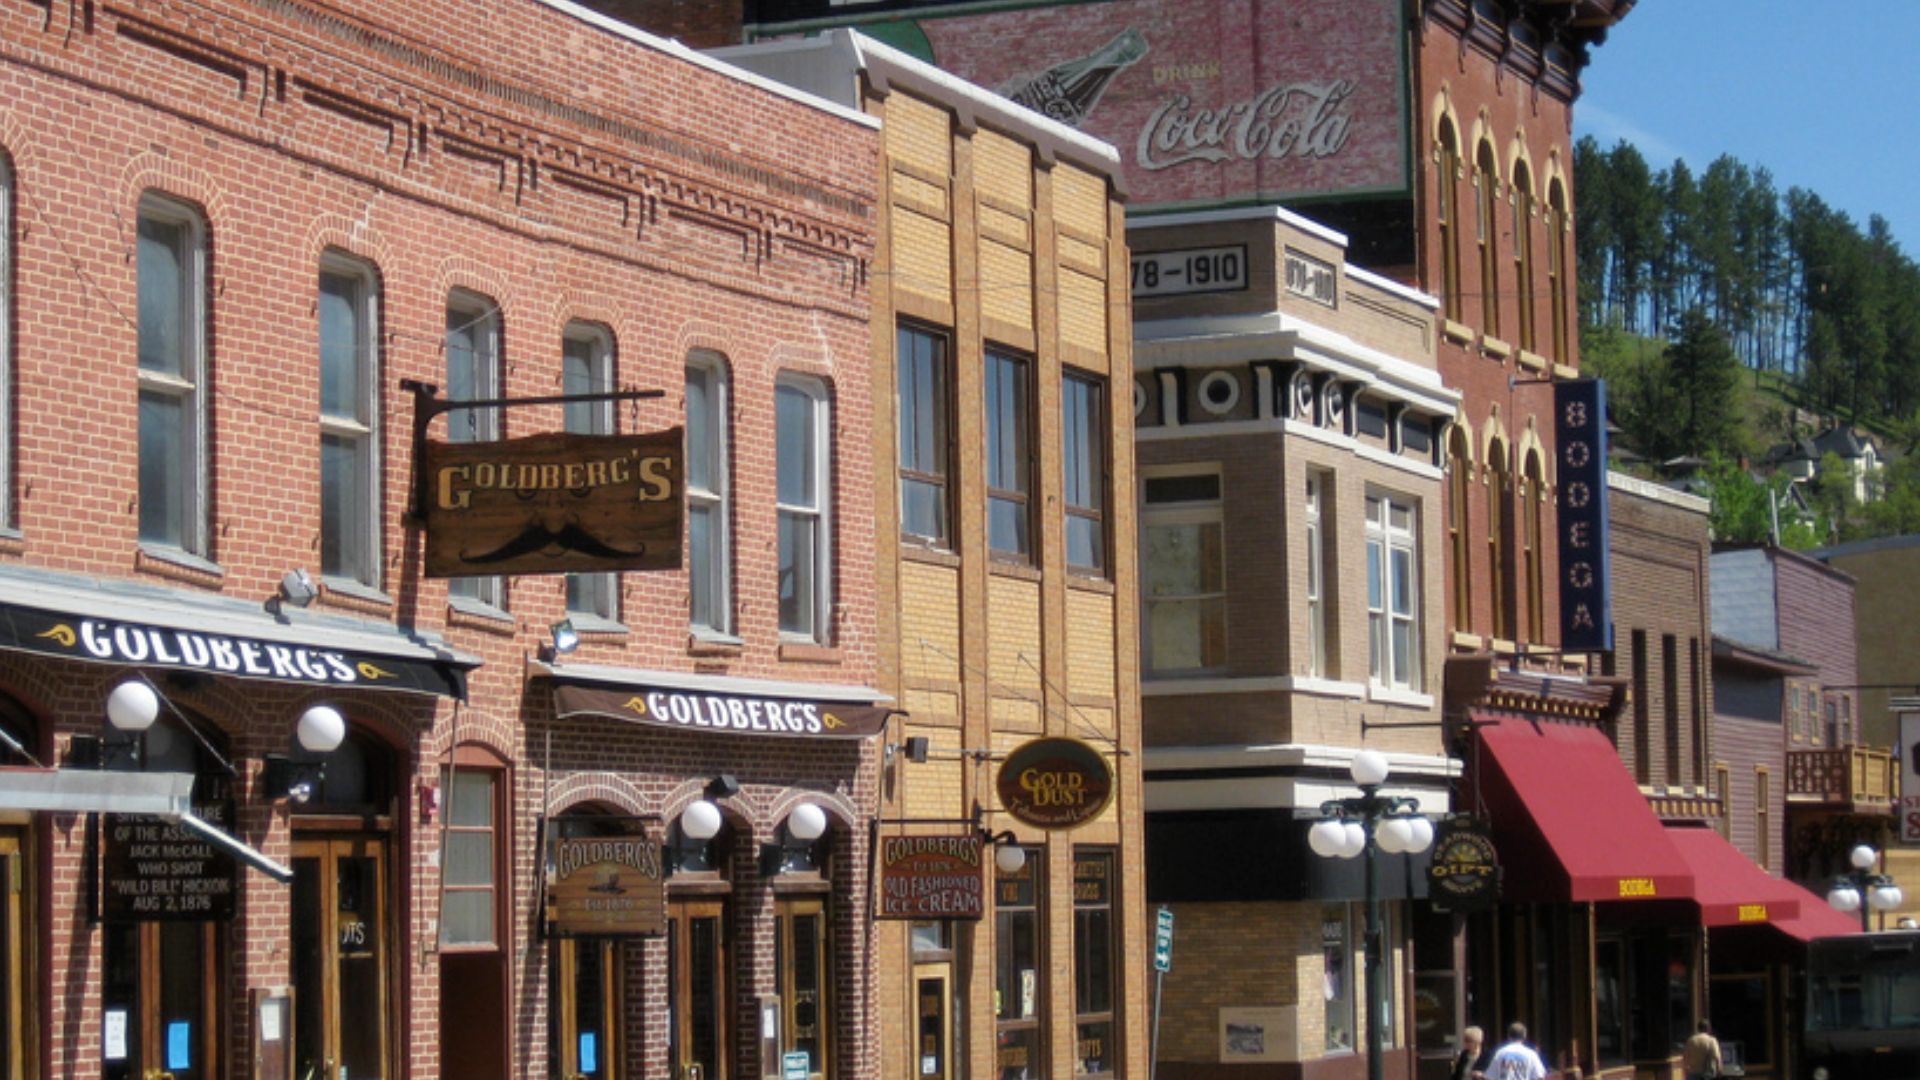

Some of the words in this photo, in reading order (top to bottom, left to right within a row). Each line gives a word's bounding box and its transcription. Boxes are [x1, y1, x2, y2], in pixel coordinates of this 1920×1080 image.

[1152, 62, 1222, 82] DRINK
[437, 449, 672, 511] GOLDBERG'S
[1565, 401, 1594, 630] BODEGA
[1020, 768, 1083, 792] GOLD
[1033, 784, 1088, 807] DUST
[113, 825, 131, 842] OF
[135, 826, 158, 841] THE
[129, 845, 159, 859] JACK
[162, 845, 214, 858] McCALL
[138, 861, 167, 875] WHO
[171, 861, 204, 875] SHOT
[885, 876, 908, 898] OLD
[911, 876, 980, 898] FASHIONED
[885, 897, 911, 913] ICE
[918, 889, 981, 913] CREAM
